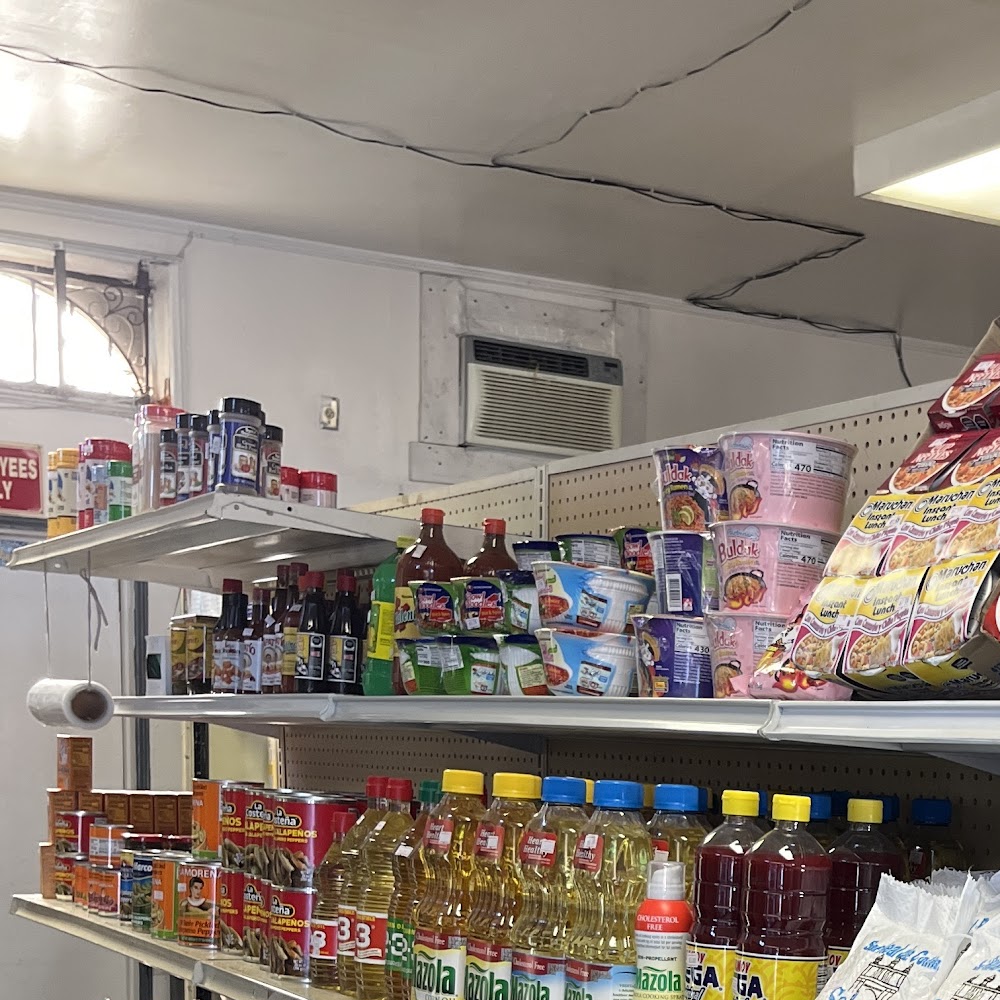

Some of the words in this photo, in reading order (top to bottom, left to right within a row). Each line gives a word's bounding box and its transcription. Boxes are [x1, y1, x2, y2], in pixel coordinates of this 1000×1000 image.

[772, 438, 804, 447] Nutrition
[0, 456, 38, 480] YEES
[794, 463, 812, 473] 470
[928, 489, 974, 508] Maruchan
[922, 512, 948, 523] Lunch
[780, 530, 811, 540] Nutrition
[718, 541, 761, 564] Buldak
[801, 555, 817, 565] 470
[820, 608, 839, 619] Lunch
[637, 915, 679, 924] CHOLESTEROL
[647, 923, 662, 932] FREE
